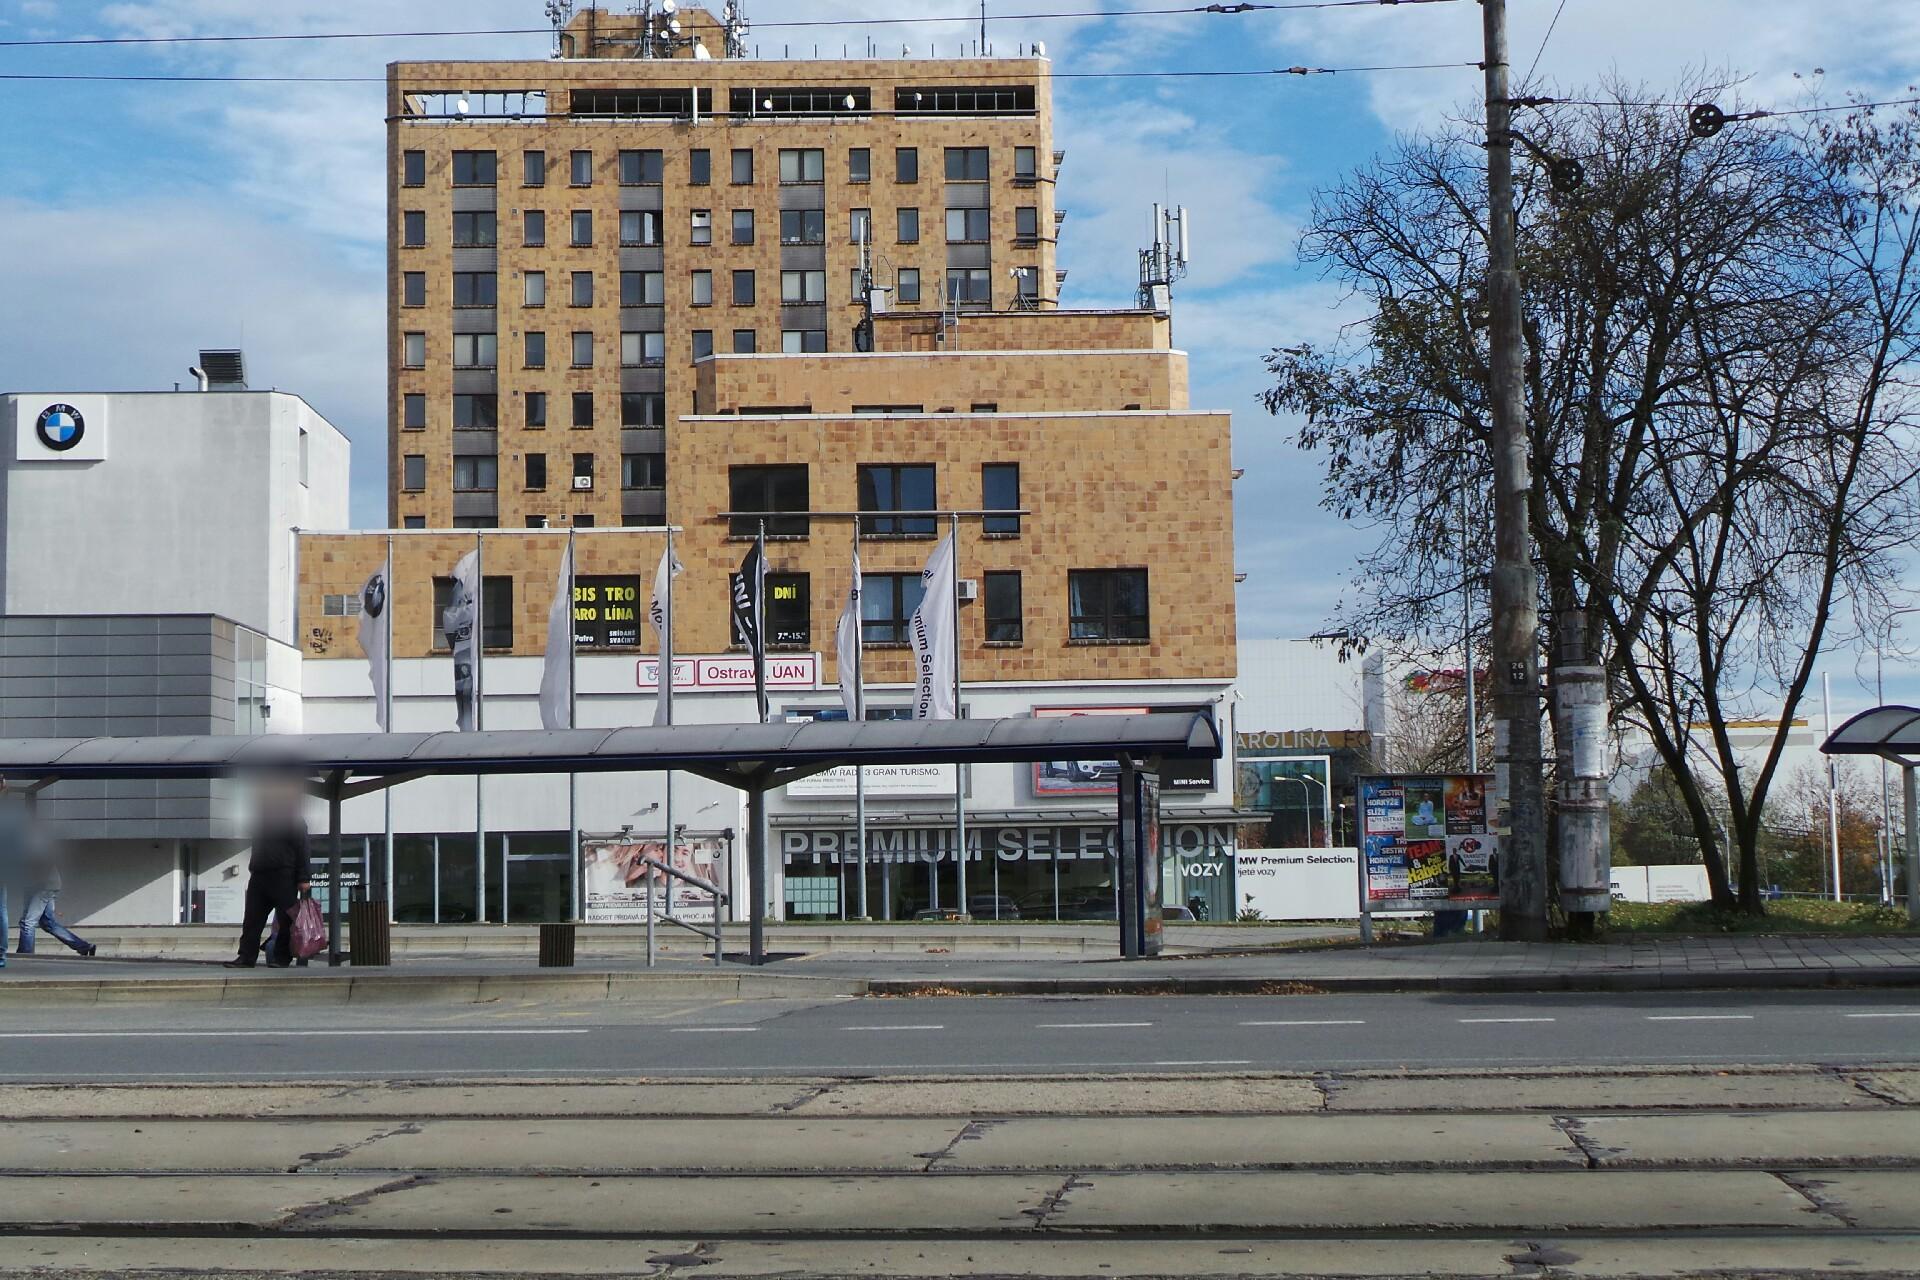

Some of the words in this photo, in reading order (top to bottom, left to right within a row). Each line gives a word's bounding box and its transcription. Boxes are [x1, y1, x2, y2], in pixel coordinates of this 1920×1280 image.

[41, 404, 81, 420] BMW
[605, 586, 635, 602] TRO
[774, 583, 796, 600] DNÍ
[574, 607, 597, 621] ARO
[605, 604, 634, 621] LÍNA
[707, 666, 769, 680] Ostrav,
[772, 662, 805, 679] ÚAN
[1512, 672, 1524, 680] 12
[919, 653, 934, 718] Selection
[1235, 732, 1331, 749] AROLINA
[839, 767, 858, 776] ŘAD
[864, 768, 871, 777] 3
[873, 768, 897, 777] GRAN
[899, 767, 941, 777] TURISMO.
[784, 829, 983, 864] PREMIUM
[997, 824, 1235, 862] SELEION
[1237, 856, 1258, 865] MW
[1261, 855, 1304, 865] Premium
[1306, 854, 1356, 864] Selection.
[1180, 862, 1224, 877] VOZY
[1257, 868, 1276, 877] vozy
[1407, 861, 1450, 884] Habera
